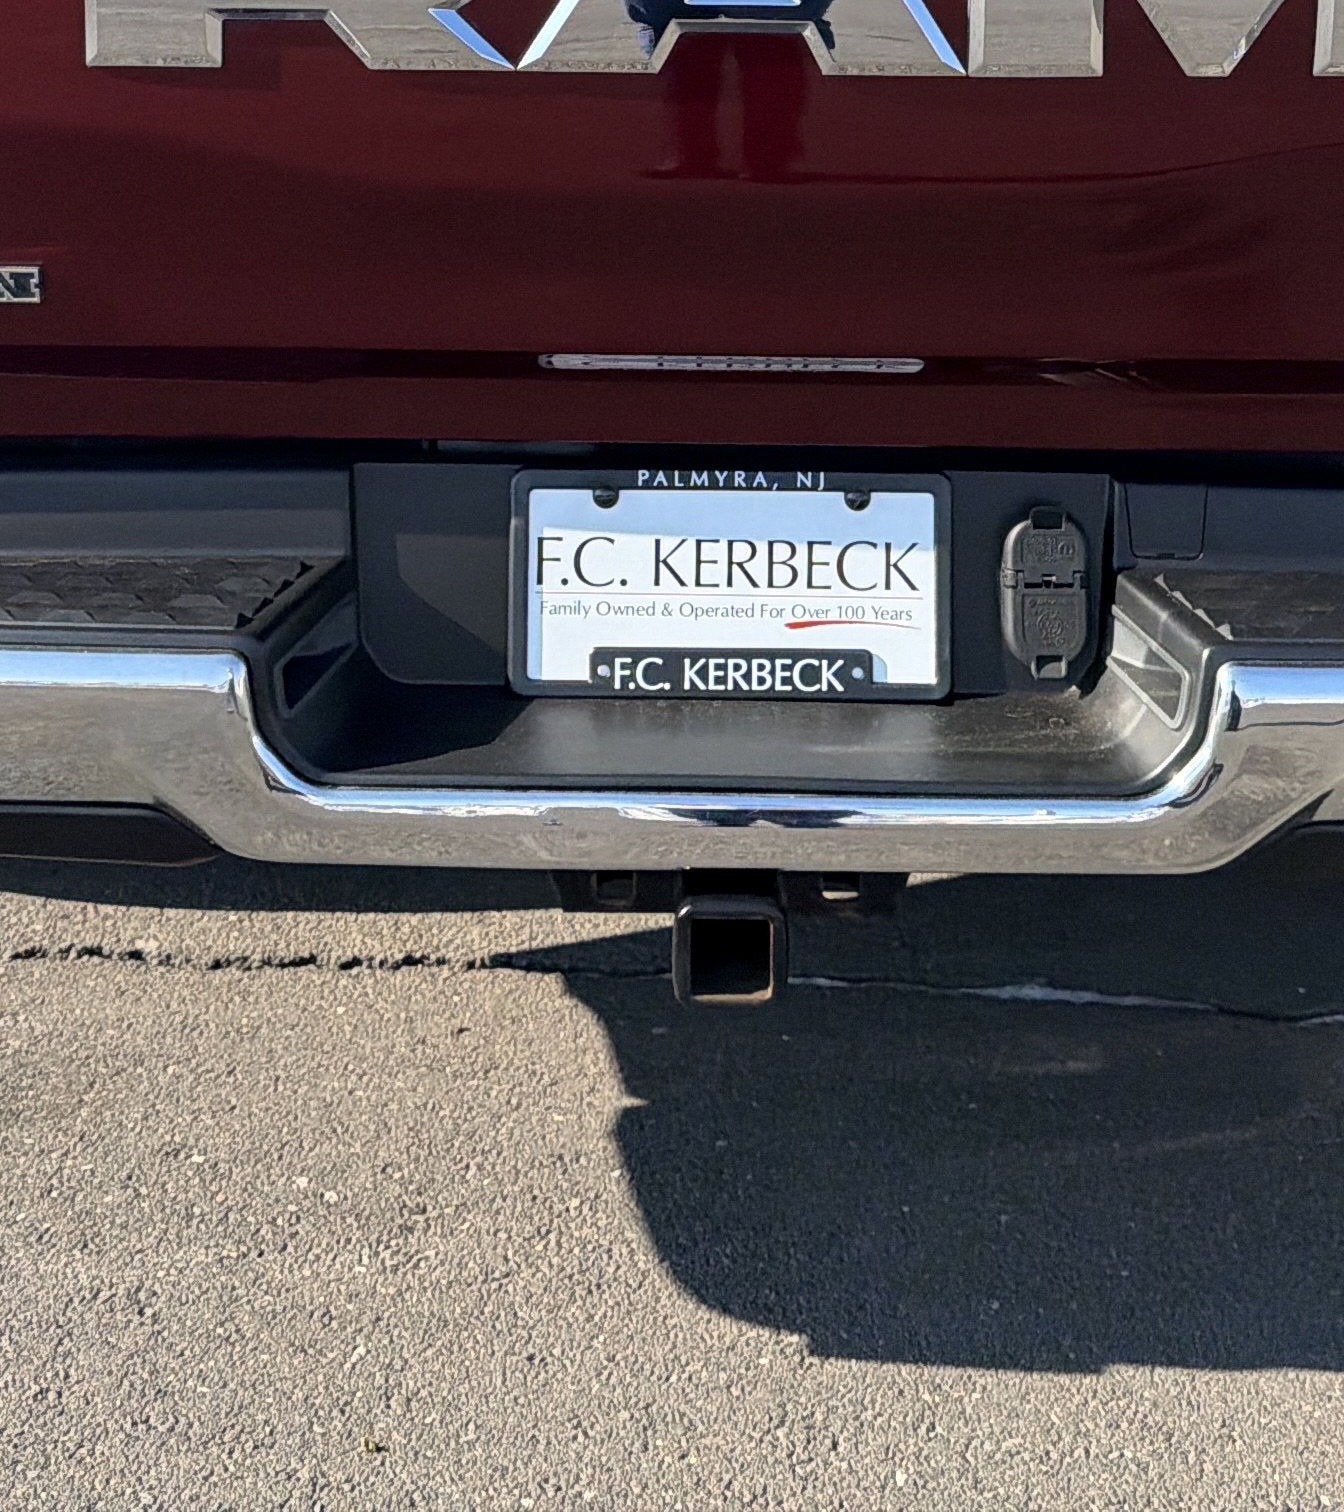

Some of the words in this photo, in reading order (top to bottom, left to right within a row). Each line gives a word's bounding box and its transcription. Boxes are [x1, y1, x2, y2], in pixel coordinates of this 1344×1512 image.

[636, 469, 779, 491] PALMYRA,
[796, 470, 825, 491] NJ
[535, 536, 629, 589] F.C.
[653, 538, 921, 592] KERBECK
[540, 600, 592, 620] Family
[595, 600, 657, 617] Owned
[661, 601, 673, 618] &
[678, 601, 755, 621] Operated
[760, 603, 786, 619] For
[791, 603, 832, 620] Over
[838, 604, 866, 620] 100
[870, 605, 913, 621] Years
[613, 656, 672, 691] F.C.
[683, 657, 845, 692] KERBECK
